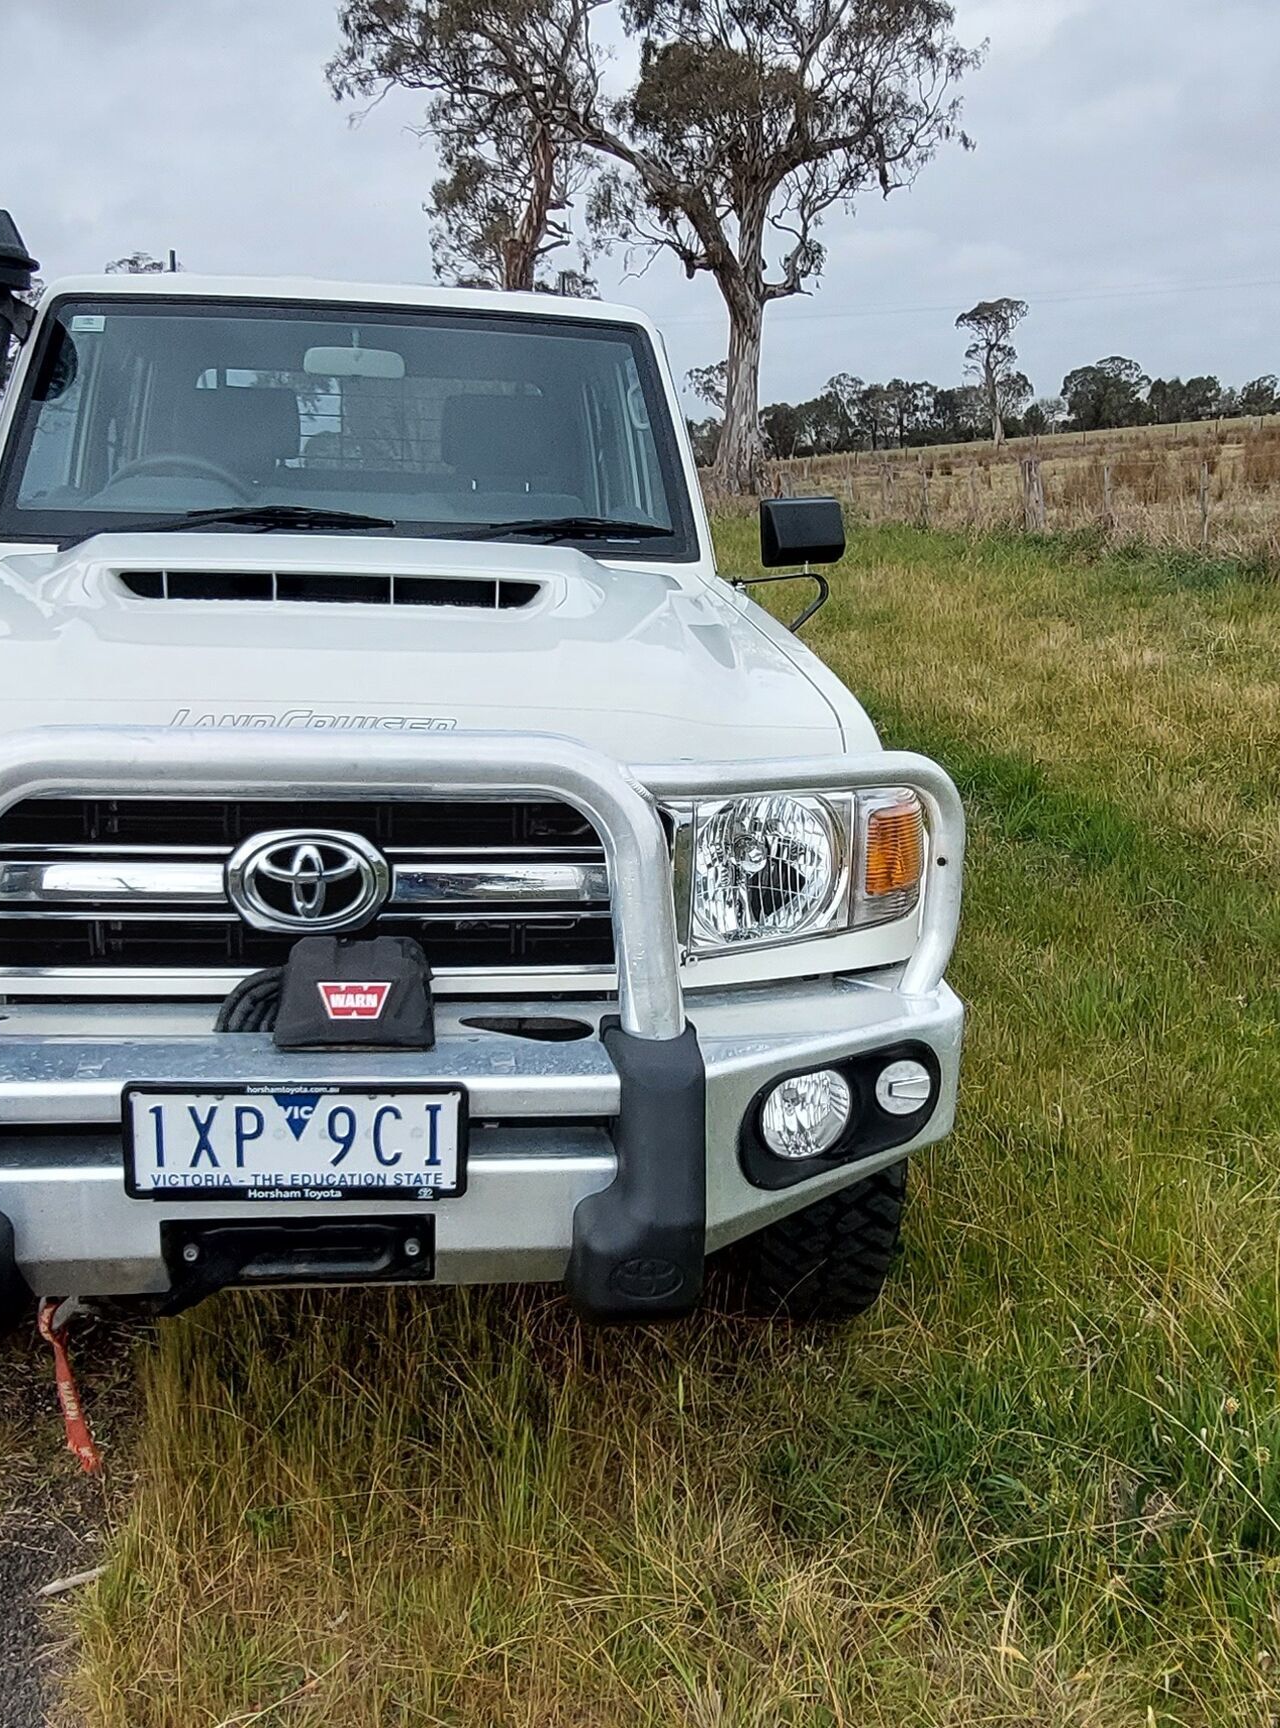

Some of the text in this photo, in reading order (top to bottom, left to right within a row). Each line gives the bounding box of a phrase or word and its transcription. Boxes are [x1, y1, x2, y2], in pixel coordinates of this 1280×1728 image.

[329, 993, 378, 1008] WARN
[246, 1085, 340, 1095] horshamtoyota.com.au
[282, 1106, 315, 1119] VIC
[149, 1104, 442, 1168] 1XP 9CI
[151, 1173, 233, 1187] VICTORIA
[251, 1173, 285, 1187] THE
[291, 1173, 389, 1187] EDUCATION
[393, 1172, 443, 1186] STATE
[247, 1188, 342, 1200] Horsham Toyota
